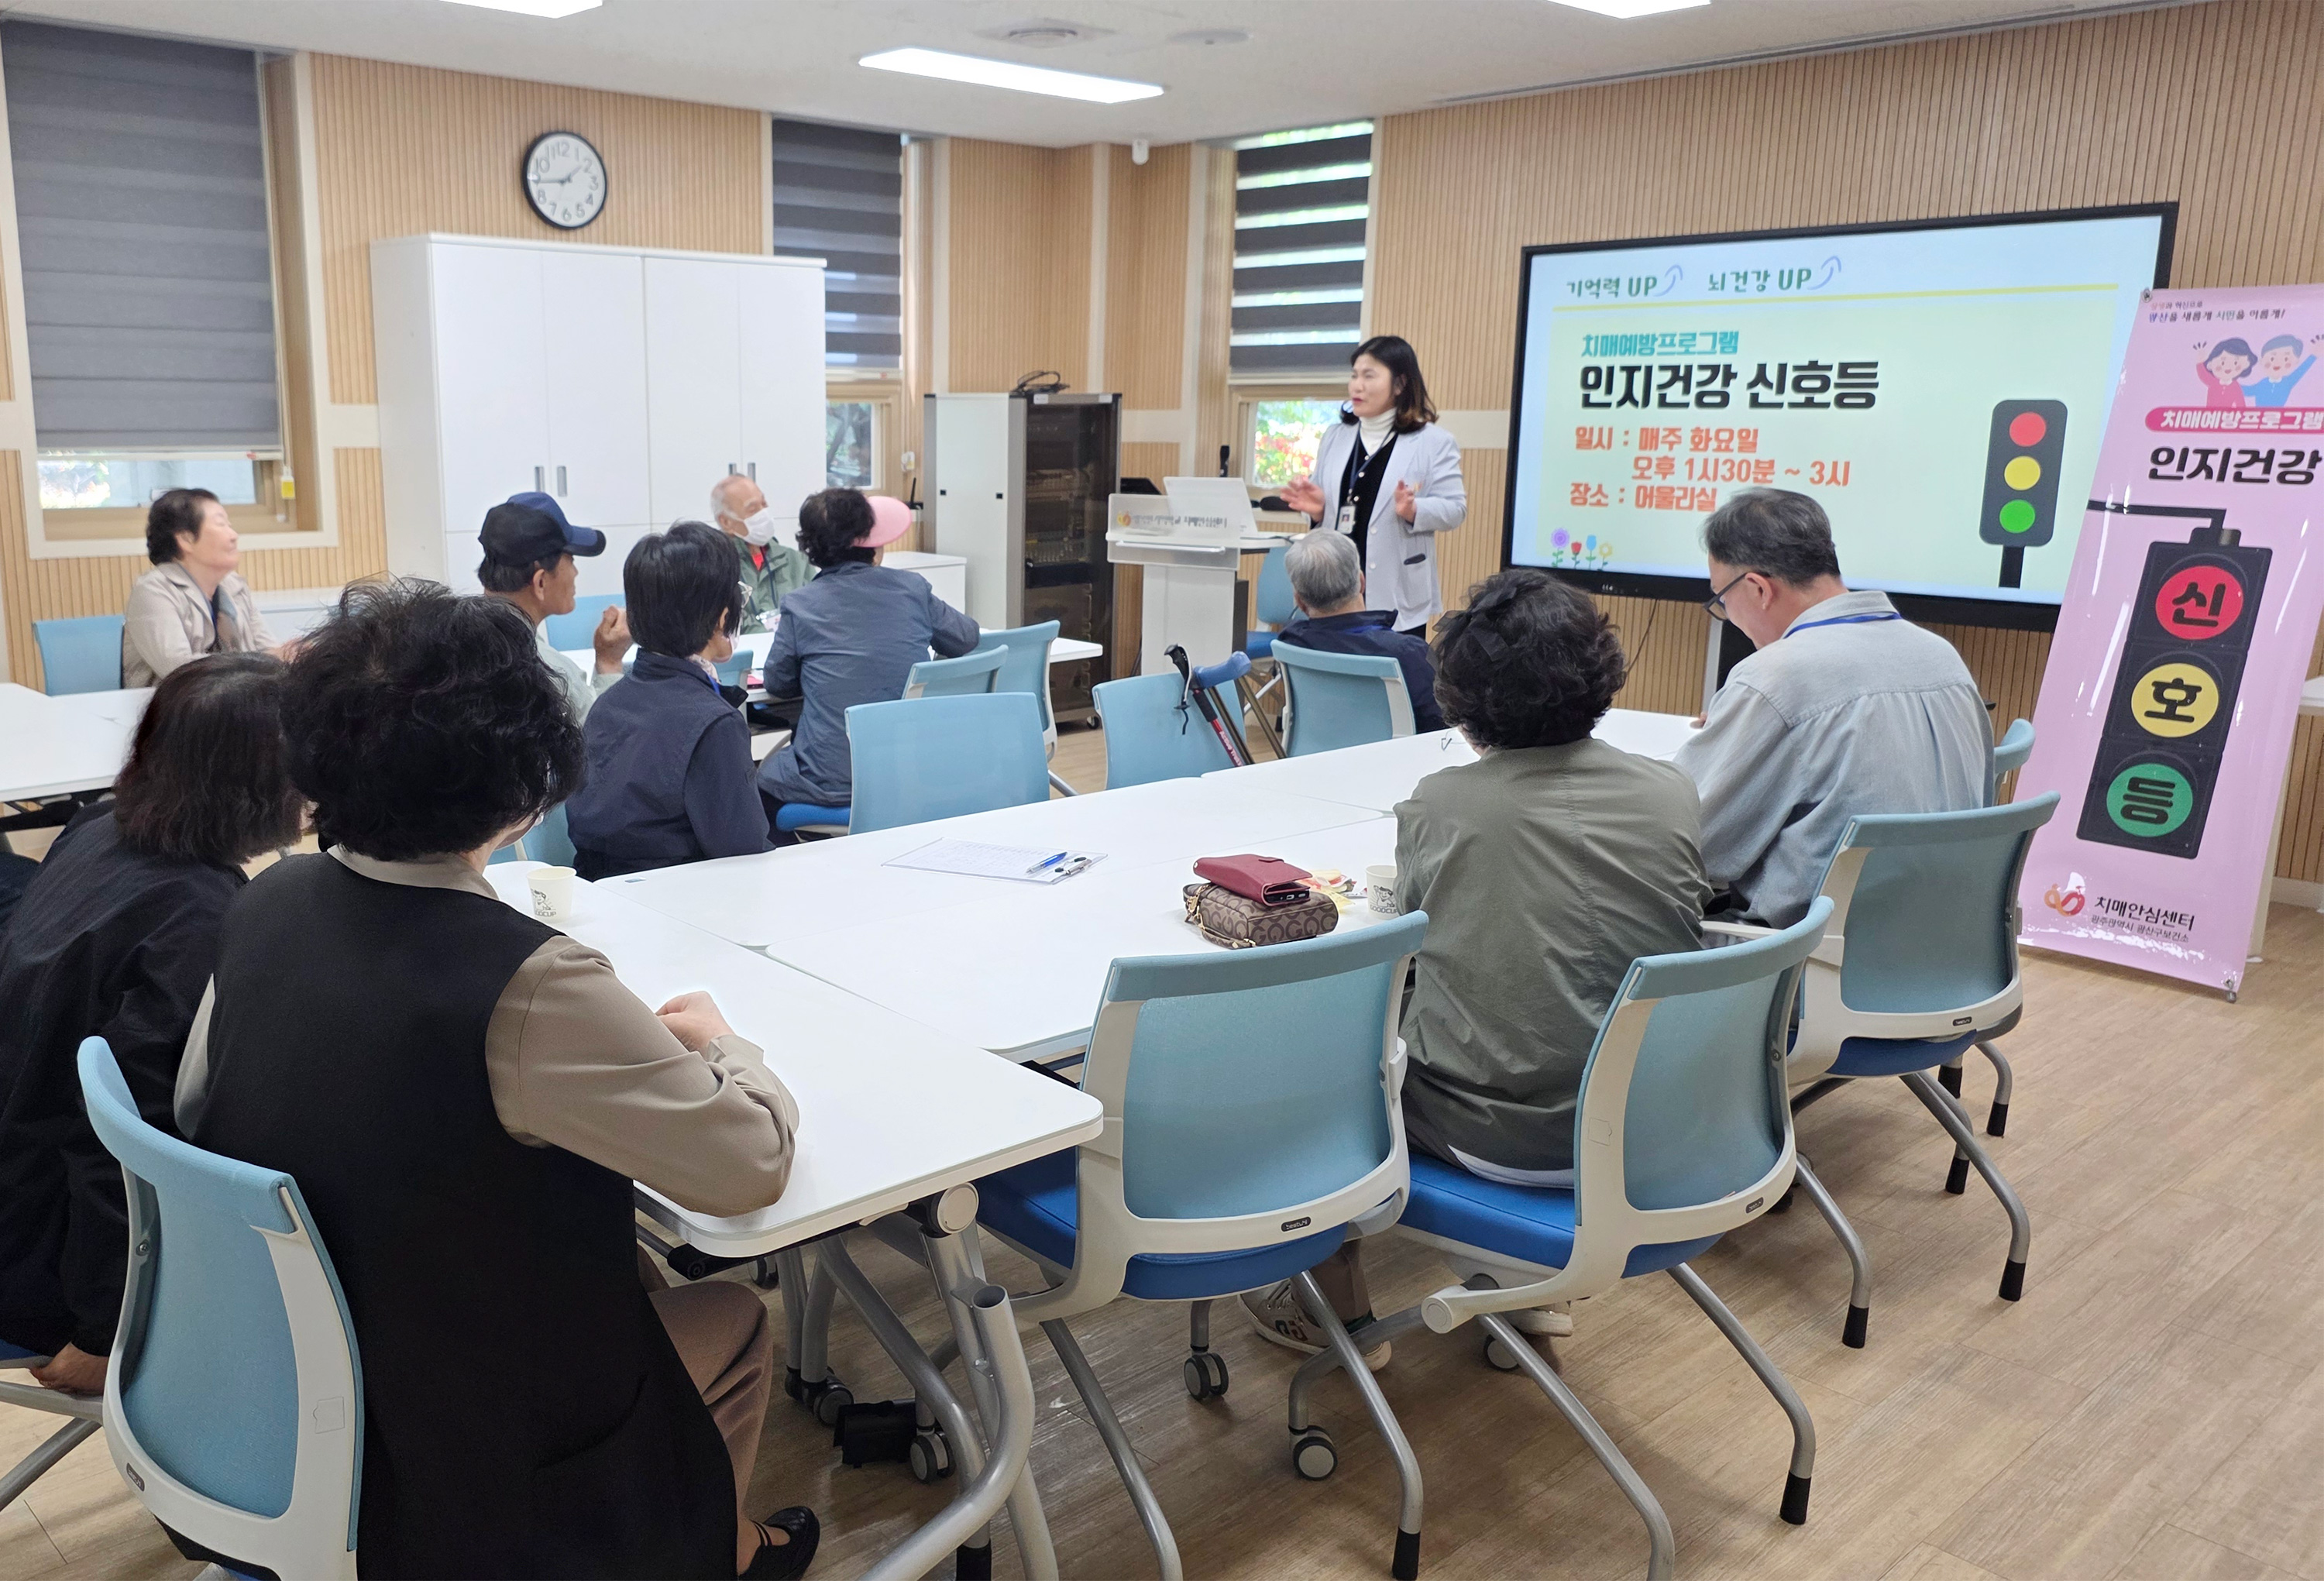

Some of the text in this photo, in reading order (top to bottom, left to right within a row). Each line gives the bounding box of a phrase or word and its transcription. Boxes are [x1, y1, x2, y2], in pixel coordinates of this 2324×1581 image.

[546, 146, 555, 160] 11
[558, 141, 570, 157] 12
[535, 157, 550, 173] 10
[583, 157, 592, 173] 2
[589, 176, 599, 191] 3
[537, 188, 547, 204] 8
[585, 193, 593, 205] 4
[549, 201, 557, 216] 7
[562, 208, 572, 222] 6
[576, 202, 585, 218] 5
[1566, 269, 1812, 298] 기억력 UP 뇌건강 UP
[1581, 331, 1739, 357] 치매예방프로그램
[1580, 359, 1879, 409] 인지건강 신호등
[2160, 411, 2324, 430] 치매예방프로그램
[1575, 426, 1613, 451] 일시
[1638, 427, 1682, 452] 매주
[1690, 427, 1758, 453] 화요일
[1631, 455, 1676, 480] 오후
[1684, 458, 1775, 484] 1시30분
[1809, 460, 1850, 486] 3시
[2148, 446, 2322, 485] 인지건강
[1570, 482, 1609, 507] 장소
[2095, 896, 2195, 931] 치매안심센터
[2091, 914, 2189, 943] 광주광역시 광산구보건소
